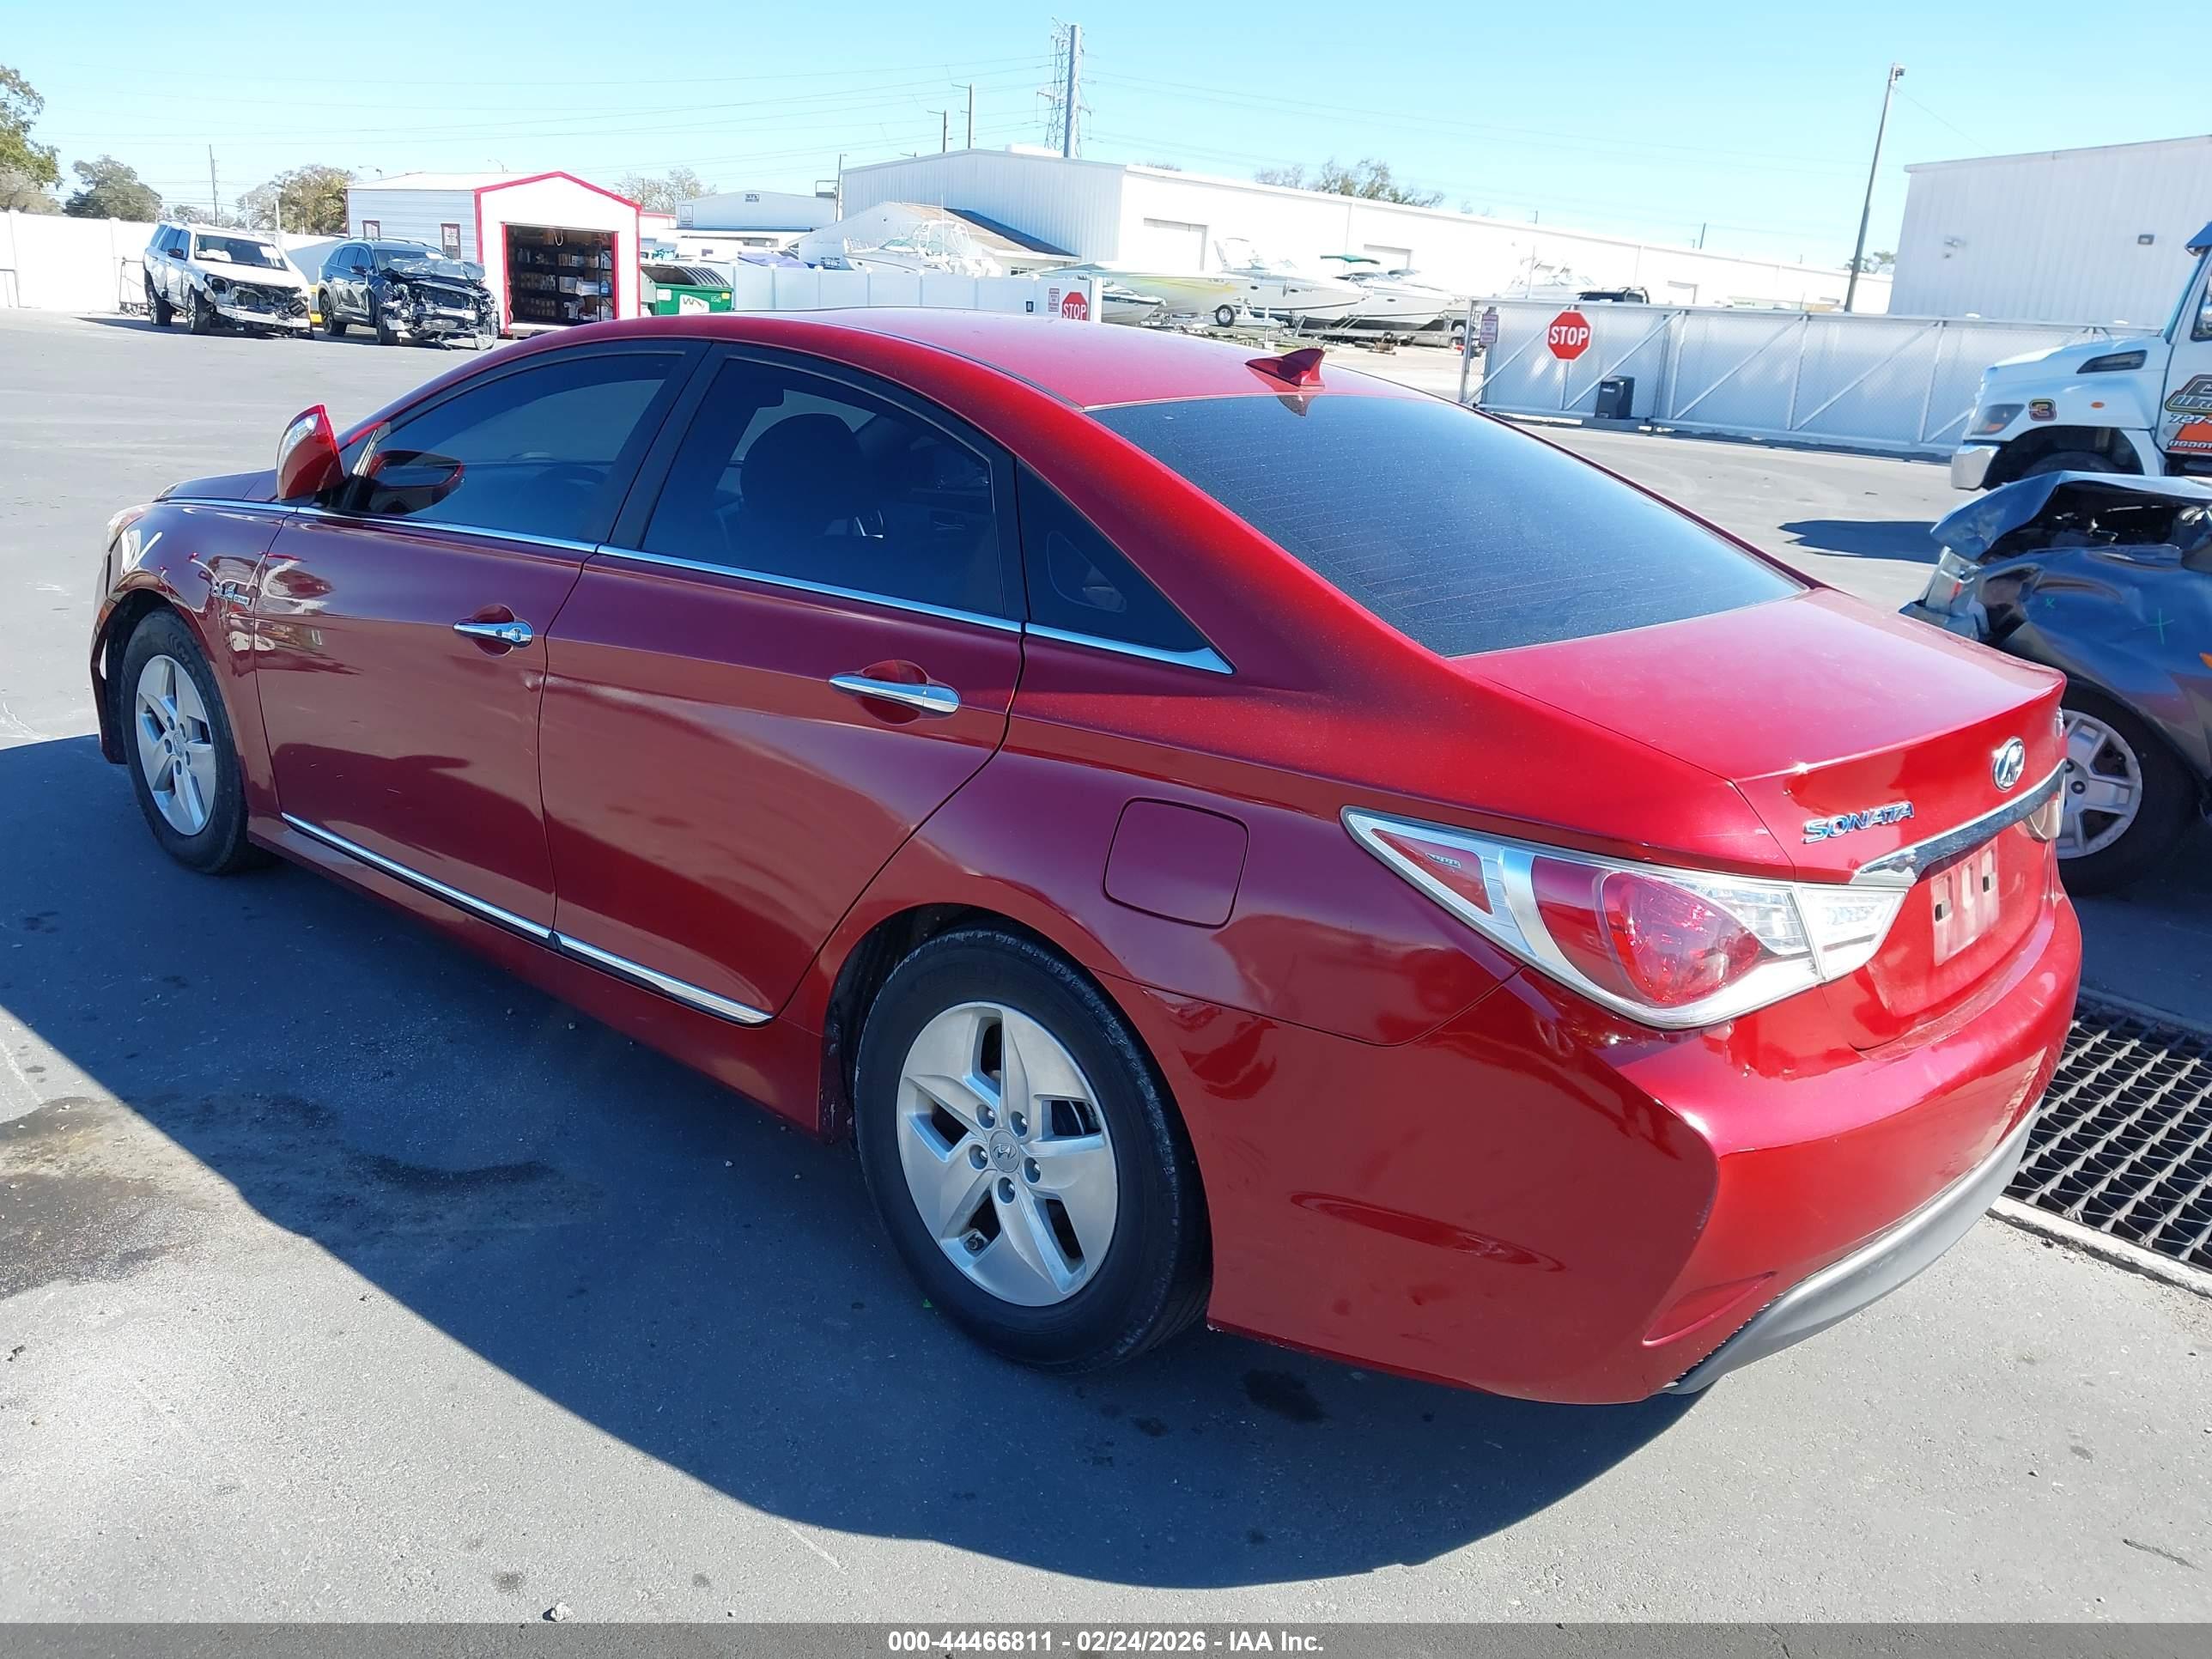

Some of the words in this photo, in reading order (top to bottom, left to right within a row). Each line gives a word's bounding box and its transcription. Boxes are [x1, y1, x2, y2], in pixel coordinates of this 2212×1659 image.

[1063, 303, 1087, 319] STOP
[1550, 325, 1589, 346] STOP
[2028, 398, 2057, 422] 3
[1801, 799, 1915, 844] SONATA
